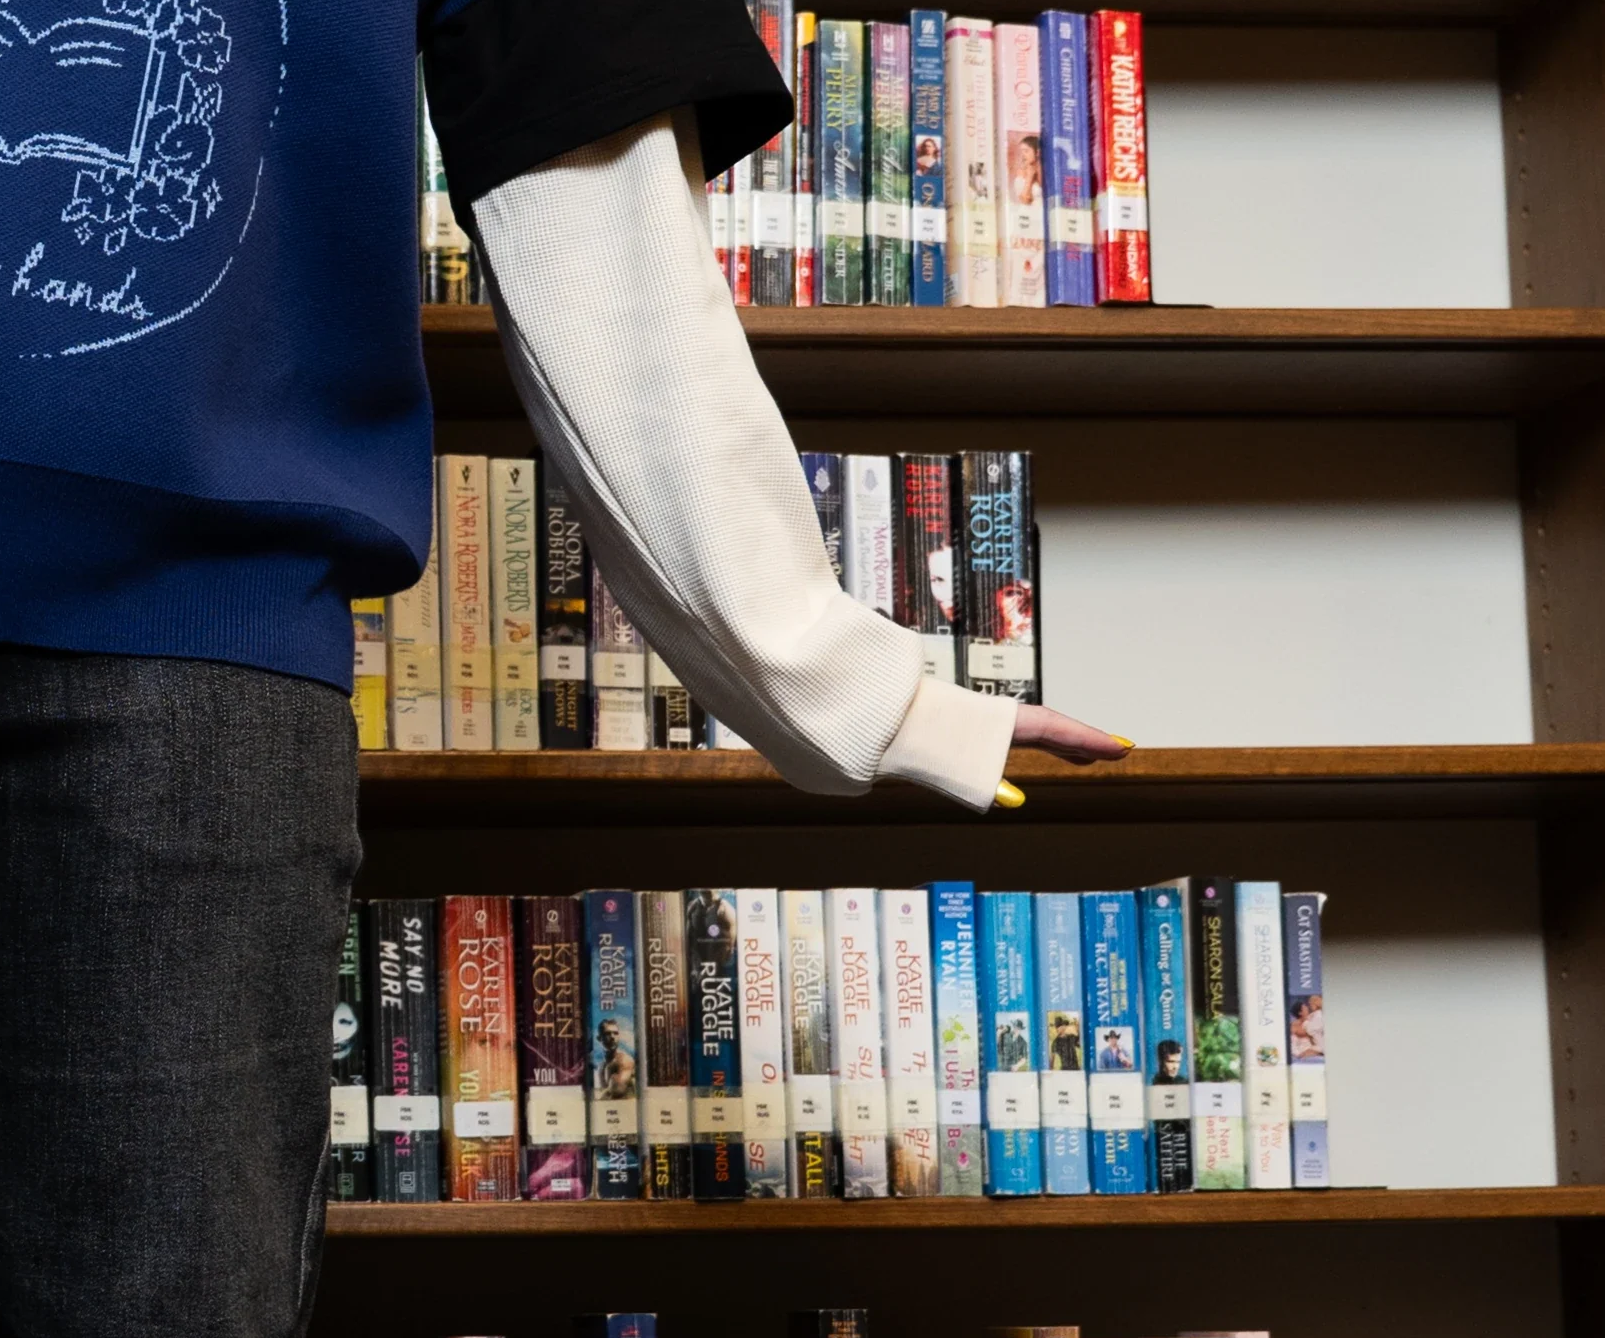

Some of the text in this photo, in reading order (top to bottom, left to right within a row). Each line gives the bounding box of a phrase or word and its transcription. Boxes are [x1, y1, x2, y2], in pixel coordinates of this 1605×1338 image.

[826, 68, 844, 131] PERRY
[845, 74, 857, 125] MARTA
[1112, 55, 1136, 179] KATHY REICHS
[13, 242, 154, 319] hands
[503, 497, 531, 612] NORA ROBERTS
[970, 494, 993, 572] ROSE
[995, 492, 1012, 574] KAREN
[379, 940, 402, 1009] MORE
[402, 917, 424, 993] SAY NO
[941, 940, 955, 990] RYAN
[957, 921, 972, 1008] JENNIFER
[1297, 904, 1315, 988] CAT SEBASTIAN
[699, 961, 718, 1056] RUGGLE
[717, 976, 732, 1040] KATIE
